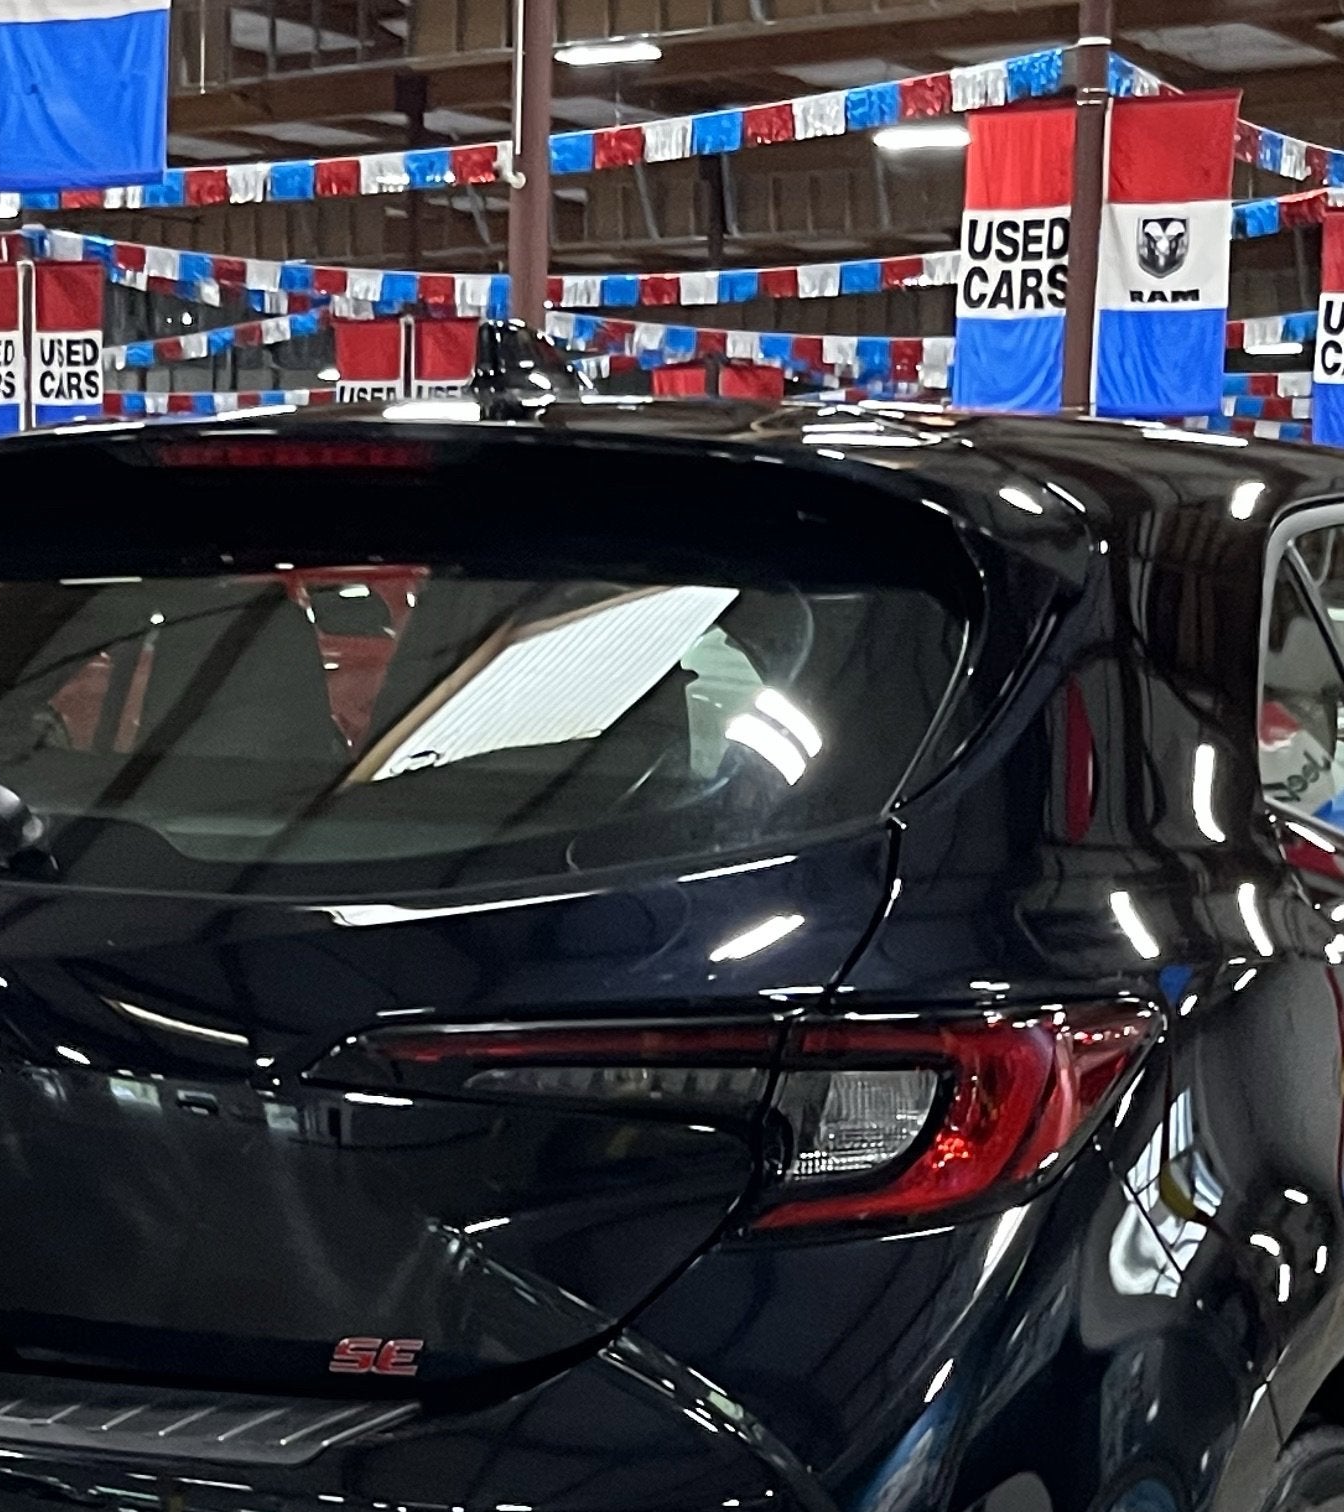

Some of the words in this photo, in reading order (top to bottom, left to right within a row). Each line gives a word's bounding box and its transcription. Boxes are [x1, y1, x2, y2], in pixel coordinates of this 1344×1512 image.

[968, 217, 1069, 262] USED
[963, 264, 1068, 310] CARS
[1129, 289, 1200, 303] RAM
[40, 338, 99, 368] USED
[39, 370, 99, 399] CARS
[328, 1336, 424, 1376] SE
